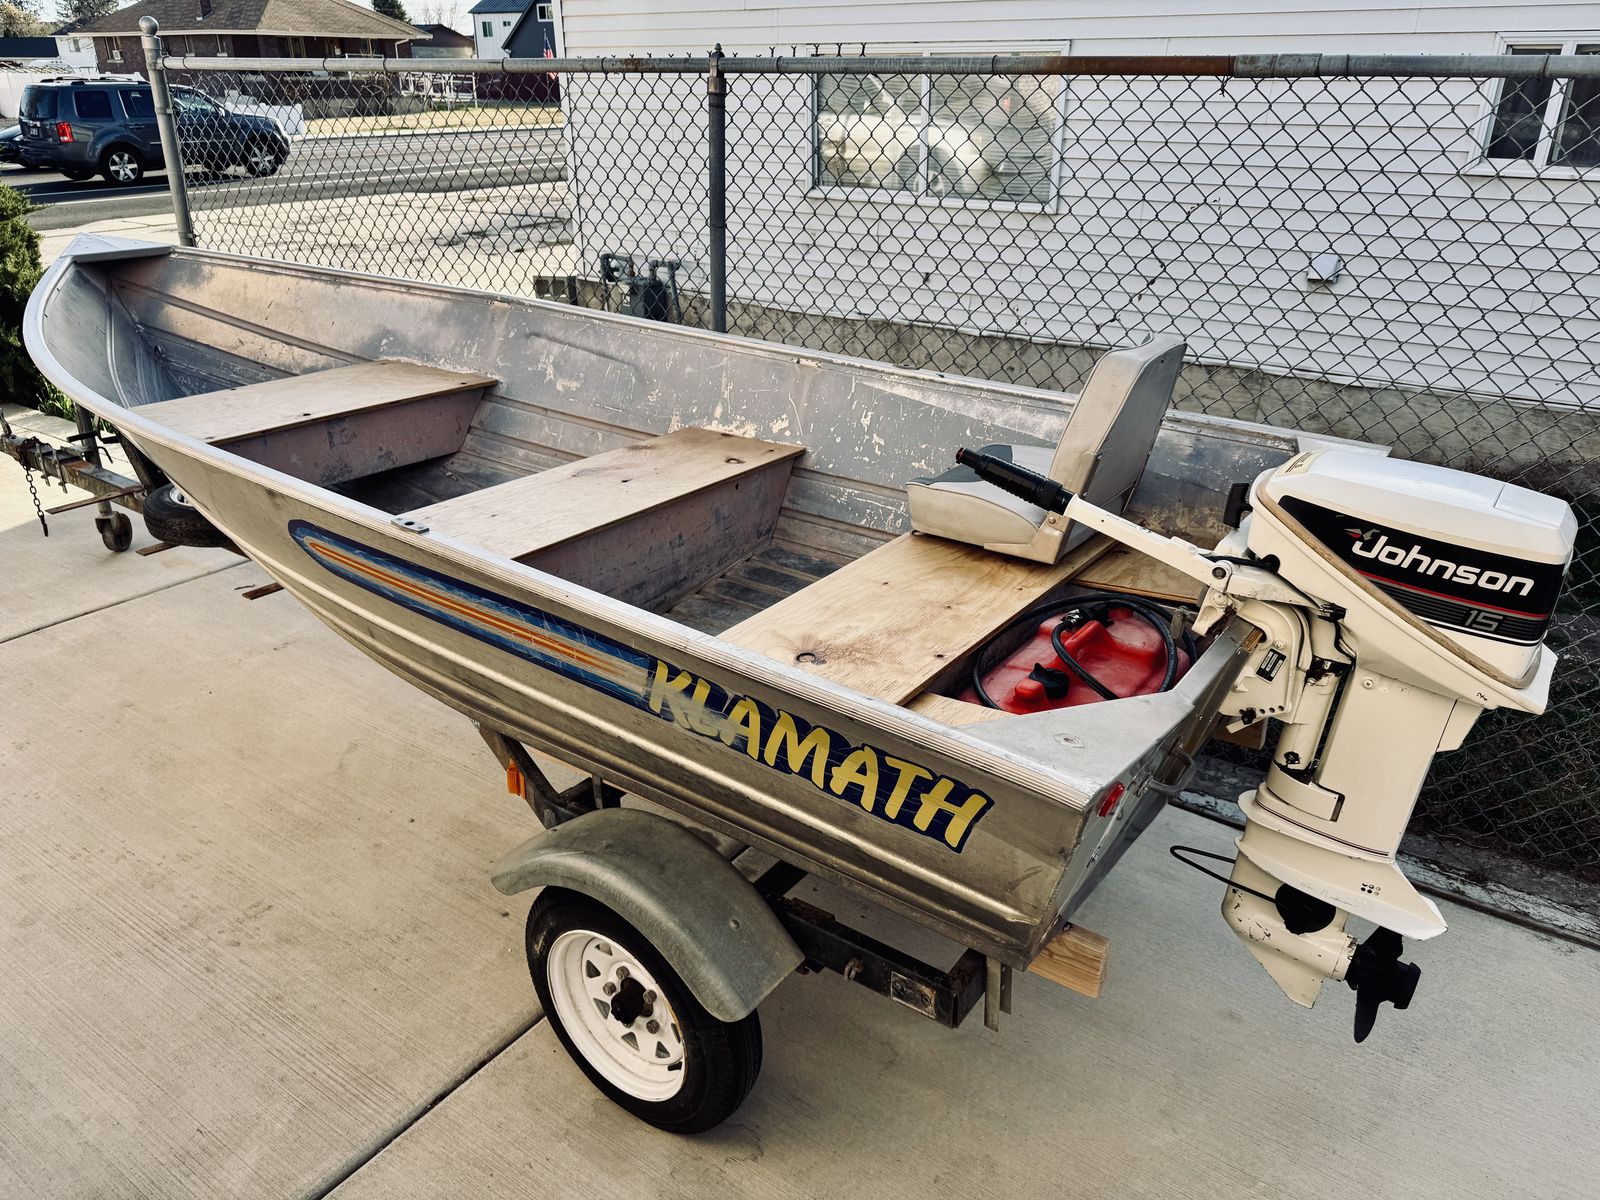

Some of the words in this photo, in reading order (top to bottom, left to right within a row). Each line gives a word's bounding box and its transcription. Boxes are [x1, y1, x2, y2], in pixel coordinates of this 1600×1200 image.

[1351, 535, 1535, 597] Johnson
[1463, 610, 1504, 632] 15
[648, 659, 987, 849] KLAMATH
